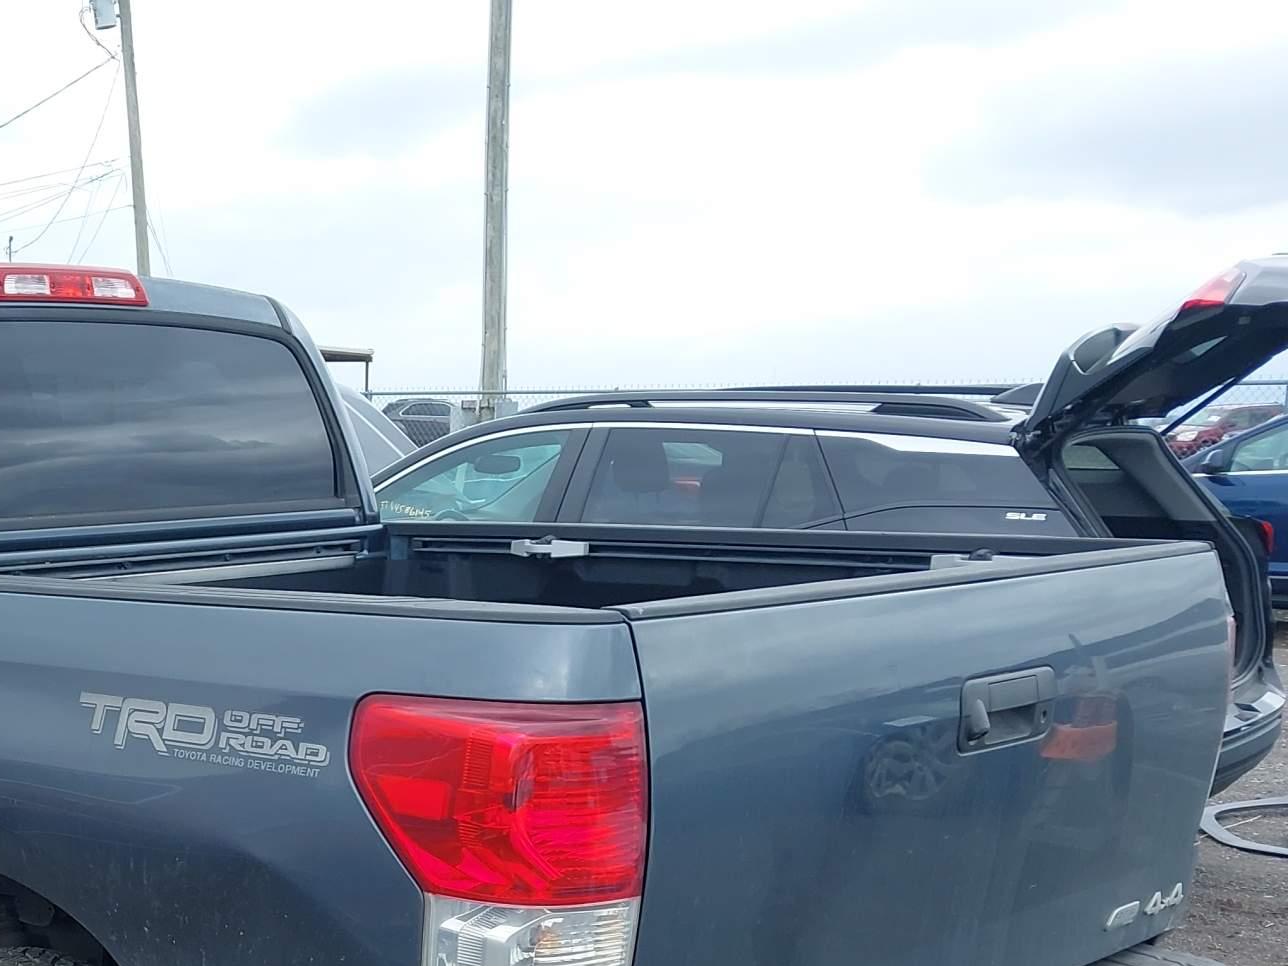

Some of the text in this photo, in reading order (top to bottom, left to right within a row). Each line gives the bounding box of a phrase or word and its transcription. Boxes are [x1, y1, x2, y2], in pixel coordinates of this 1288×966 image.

[1005, 512, 1047, 520] SLE
[79, 691, 218, 756] TRD
[223, 710, 305, 736] OFF
[173, 748, 321, 778] TOYOTA RACING DEVELOPMENT
[218, 732, 330, 766] ROAD
